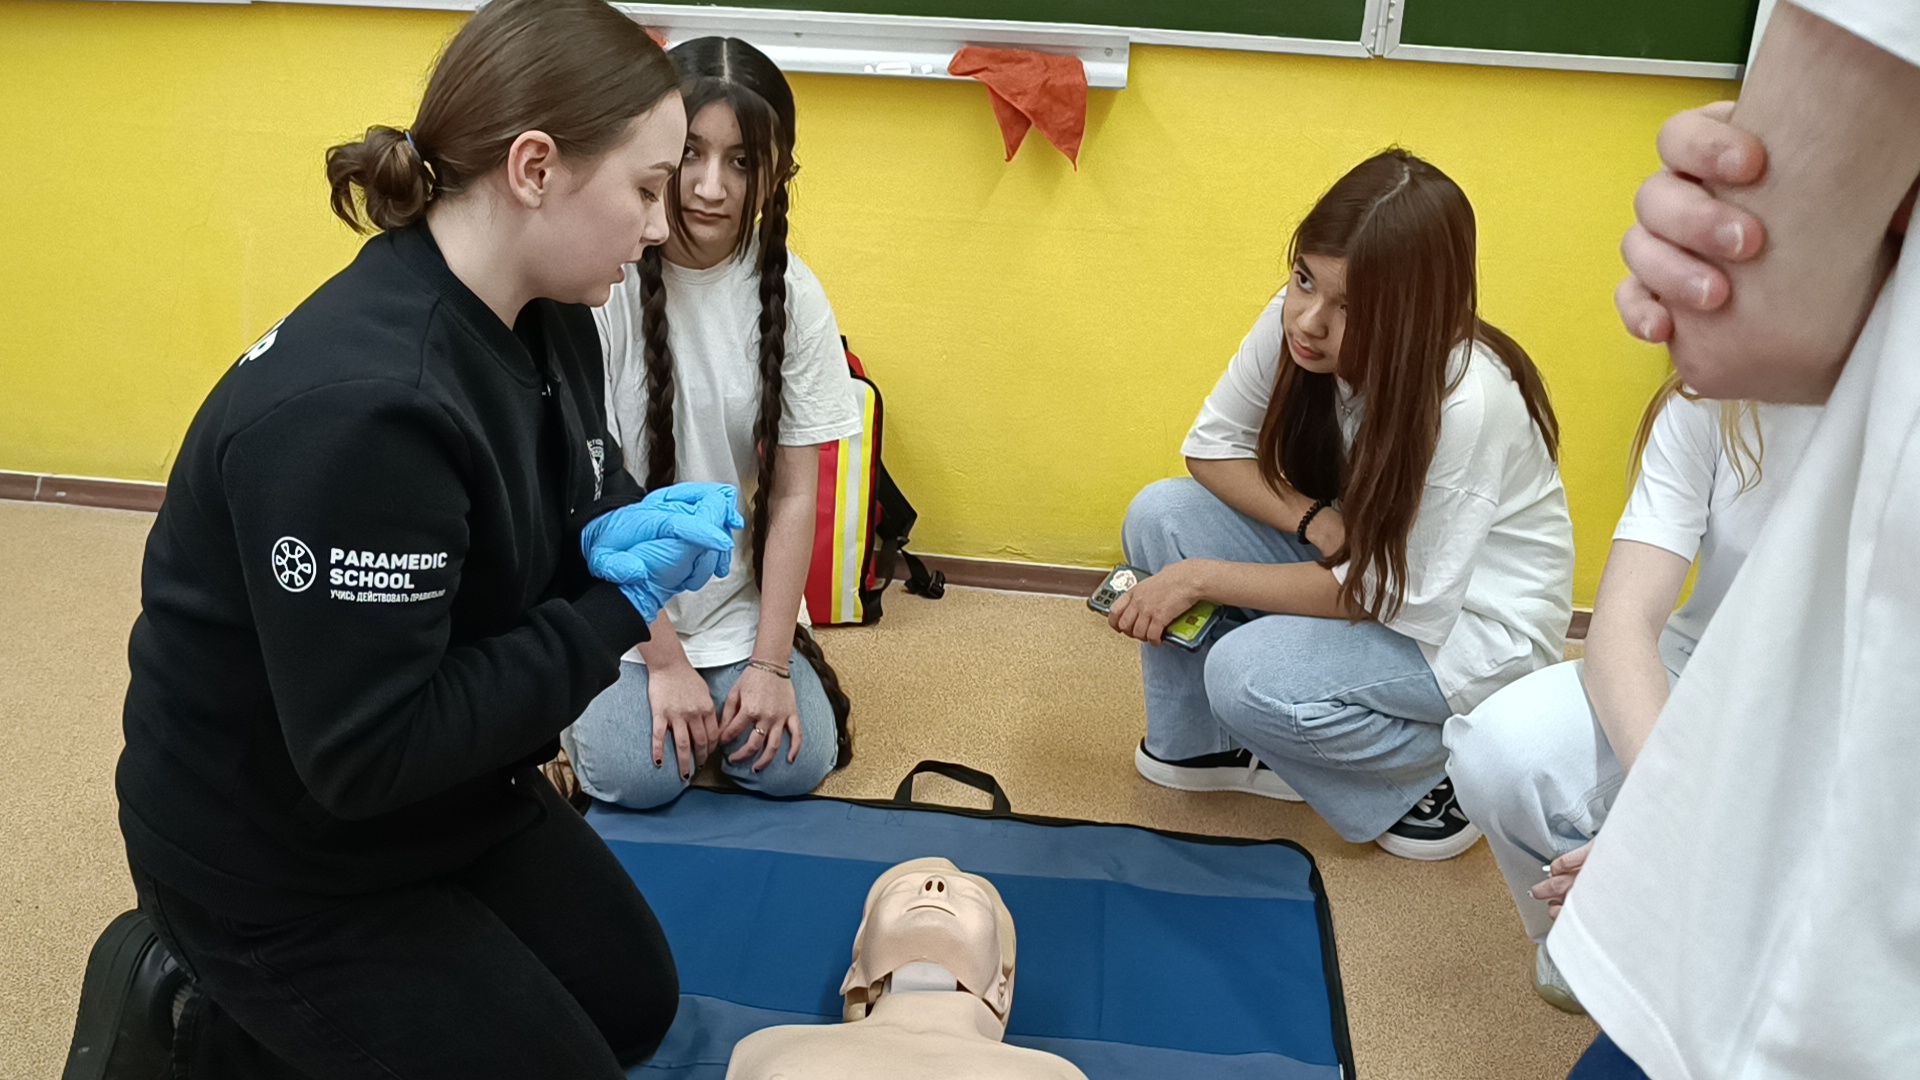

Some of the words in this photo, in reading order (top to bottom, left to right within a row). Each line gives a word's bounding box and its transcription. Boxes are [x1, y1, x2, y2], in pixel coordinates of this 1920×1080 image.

[330, 548, 448, 570] PARAMEDIC
[329, 568, 415, 589] SCHOOL
[330, 589, 356, 601] УЧИСЬ
[356, 590, 410, 603] ДЕЙСТВОВАТЬ
